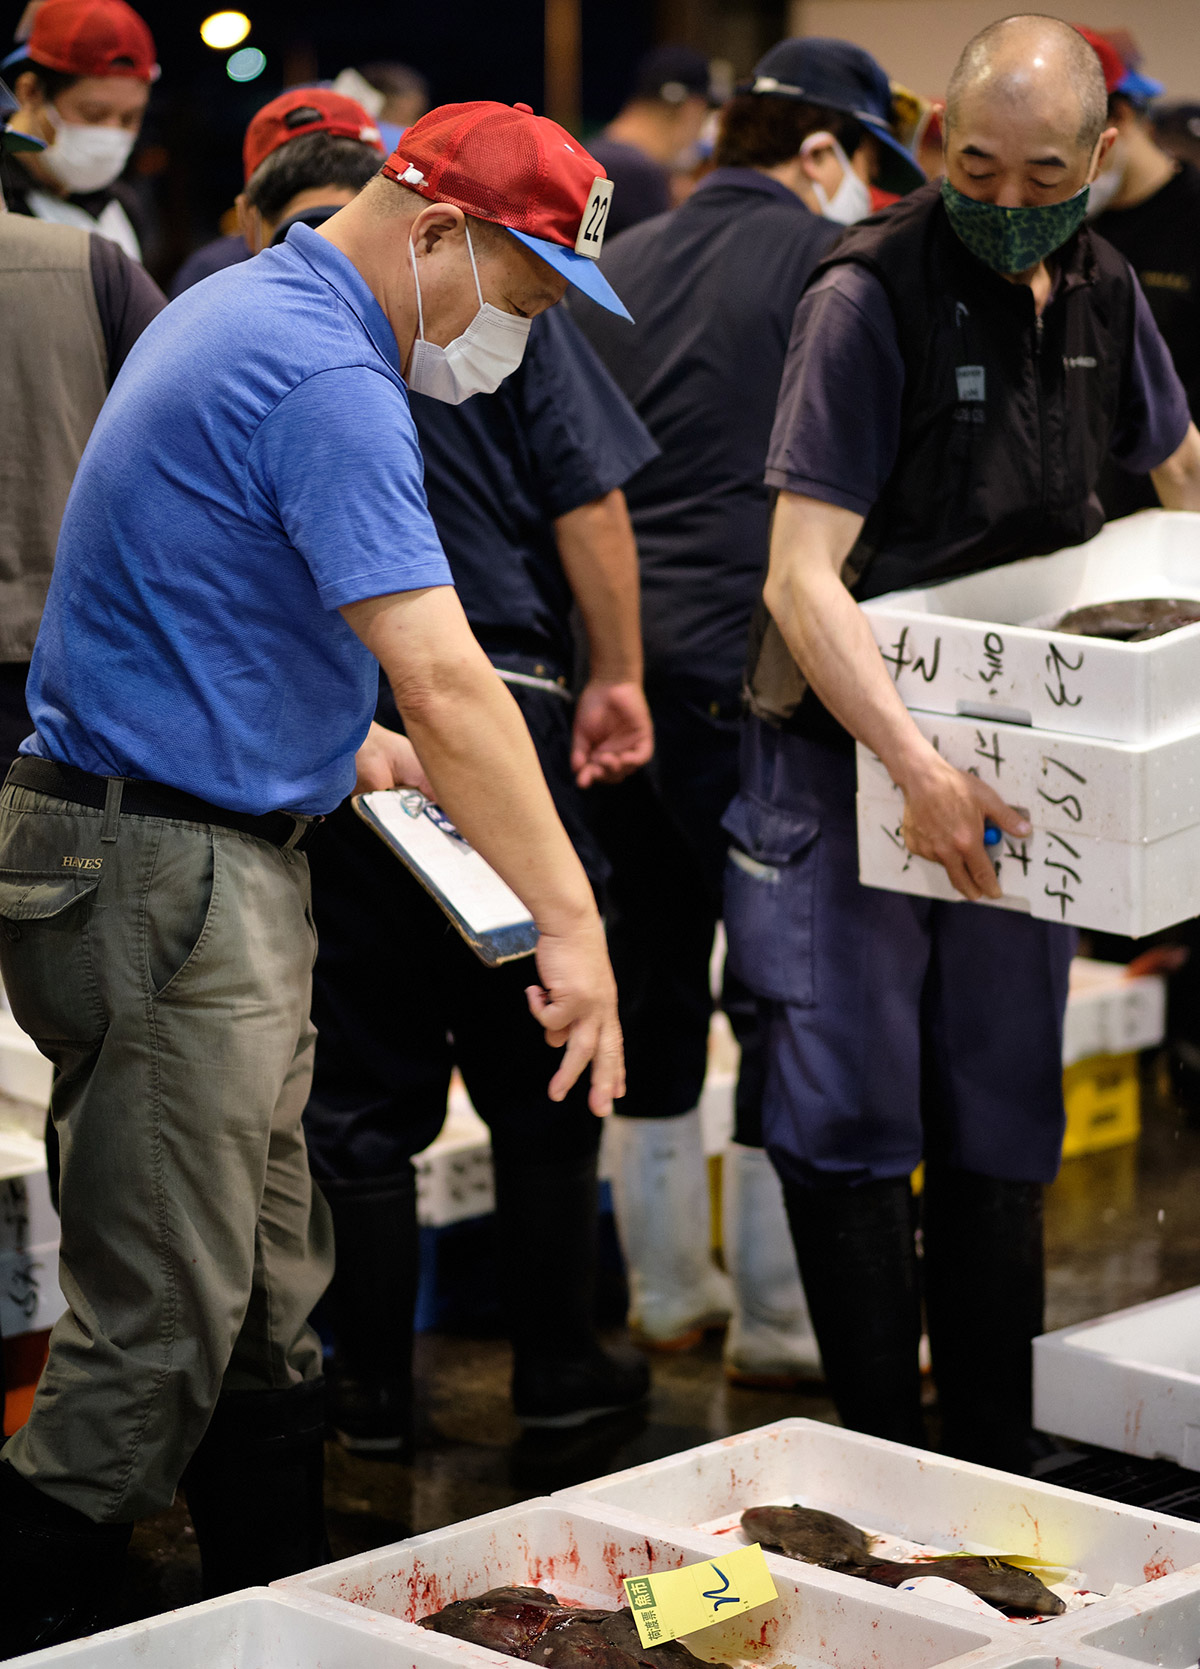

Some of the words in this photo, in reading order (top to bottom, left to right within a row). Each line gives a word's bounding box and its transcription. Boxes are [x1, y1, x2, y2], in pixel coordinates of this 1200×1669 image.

[583, 194, 608, 242] 22
[630, 1581, 653, 1608] 魚市
[641, 1610, 663, 1641] 荷渡票
